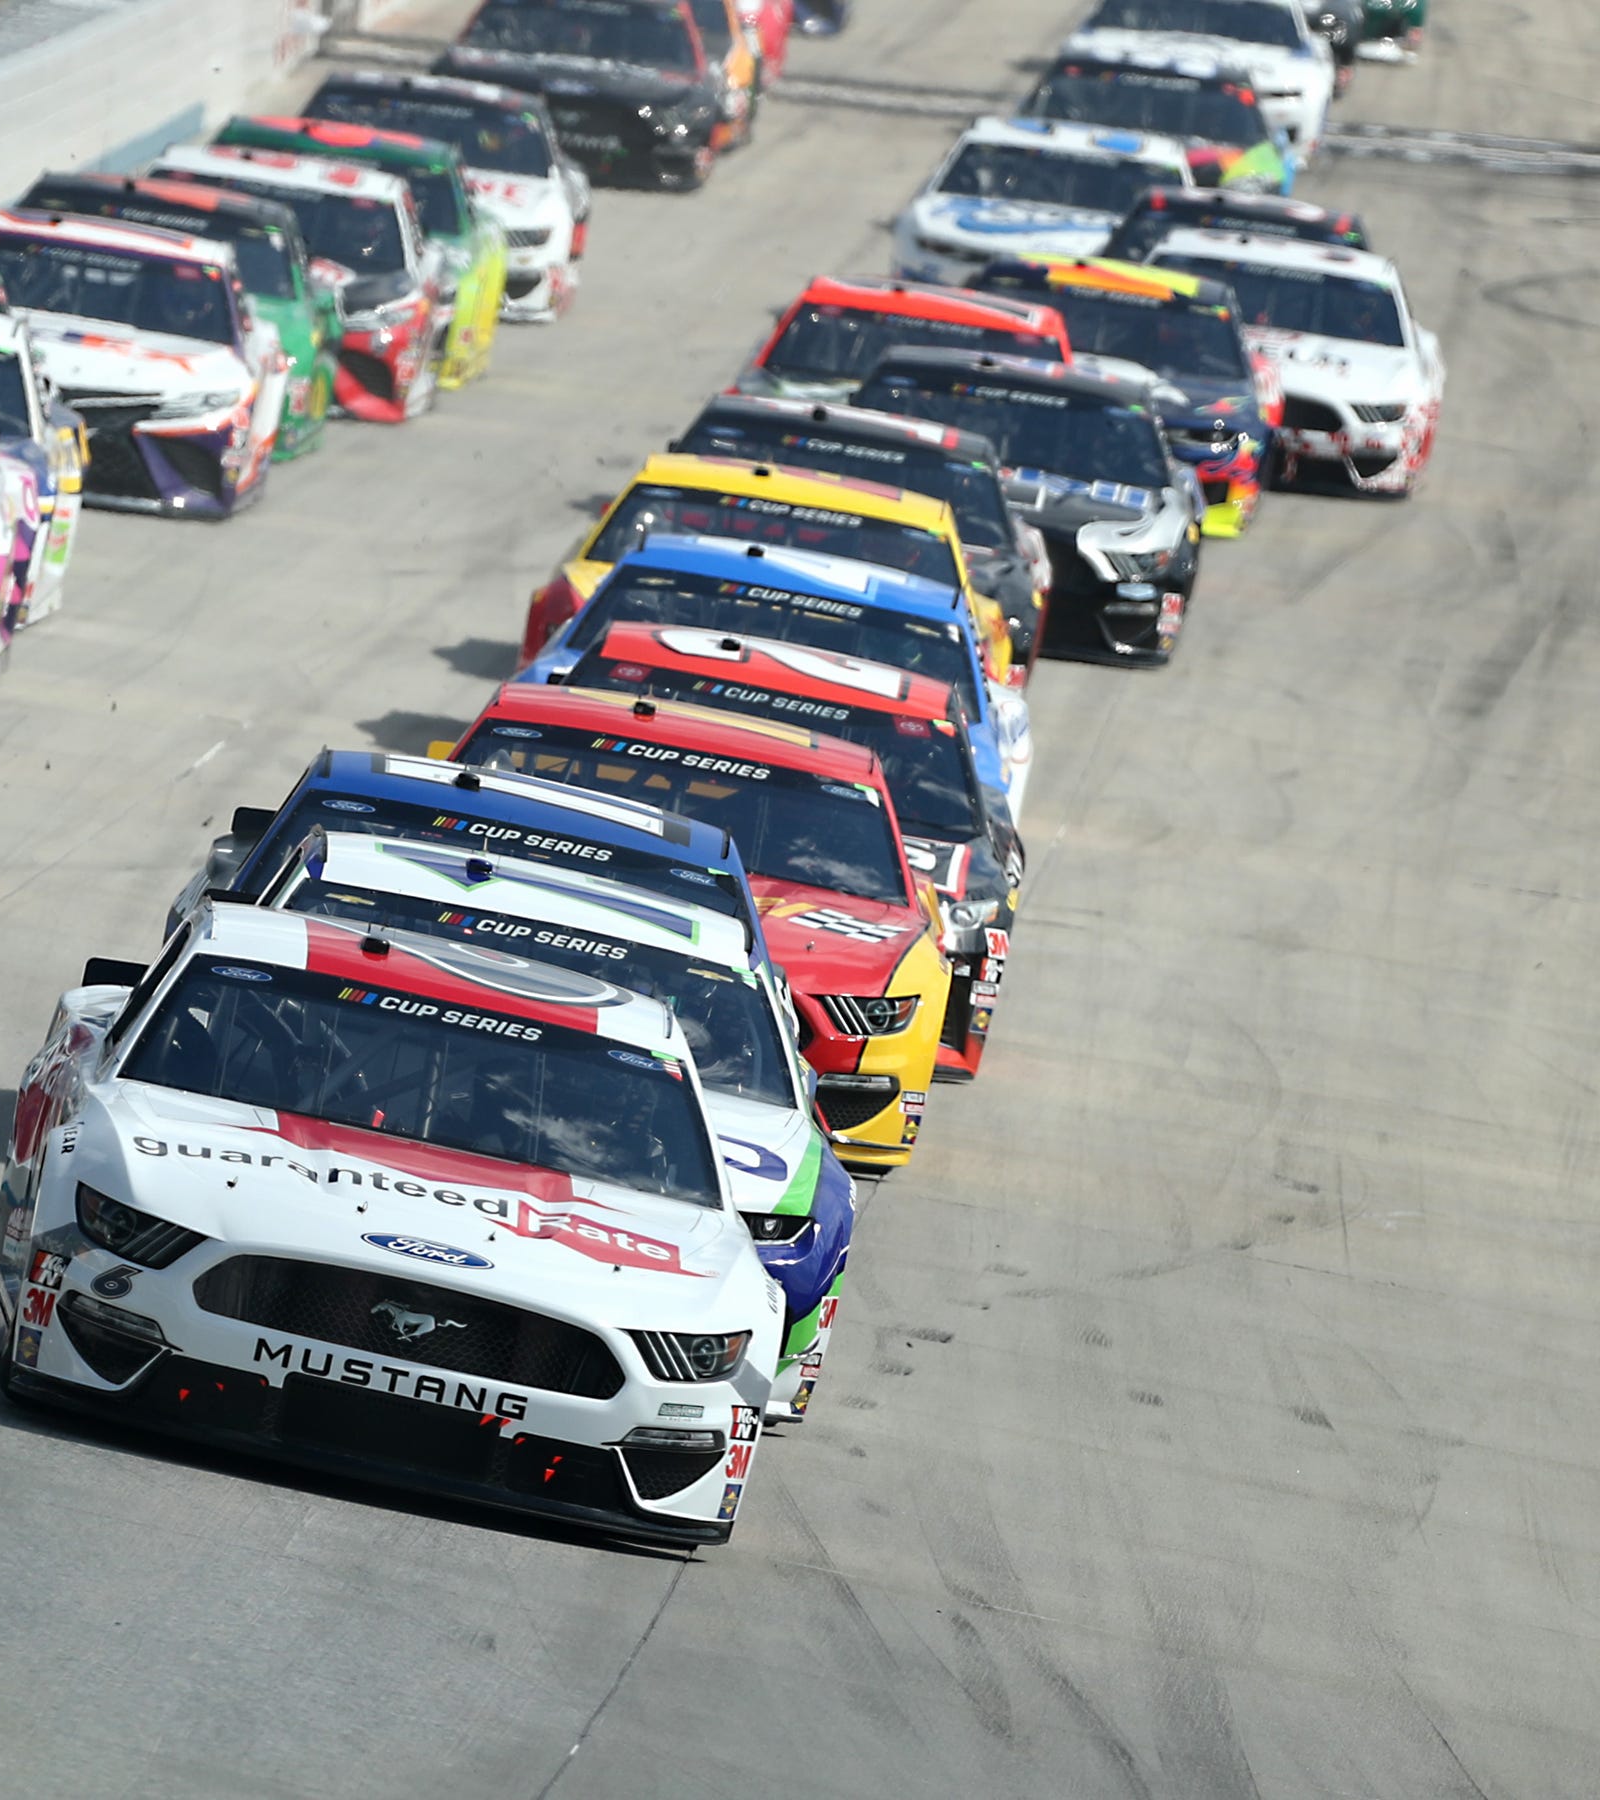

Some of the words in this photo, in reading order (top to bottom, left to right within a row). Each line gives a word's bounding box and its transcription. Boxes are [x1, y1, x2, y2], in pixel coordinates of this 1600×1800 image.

[806, 437, 844, 454] CUP
[846, 444, 906, 463] SERIES
[748, 500, 791, 515] CUP
[794, 507, 863, 528] SERIES
[747, 587, 792, 604] CUP
[794, 596, 863, 618] SERIES
[723, 687, 770, 703] CUP
[772, 698, 850, 721] SERIES
[628, 743, 679, 760] CUP
[681, 755, 771, 780] SERIES
[468, 823, 520, 840] CUP
[523, 834, 613, 862] SERIES
[475, 919, 531, 938] CUP
[533, 931, 628, 960] SERIES
[988, 931, 1009, 956] 3M
[378, 996, 438, 1018] CUP
[441, 1010, 543, 1041] SERIES
[133, 1132, 509, 1220] guaranteed
[526, 1209, 674, 1262] Rate
[89, 1264, 144, 1300] 6
[22, 1287, 57, 1328] 3M
[253, 1337, 529, 1421] MUSTANG
[725, 1444, 752, 1479] 3M
